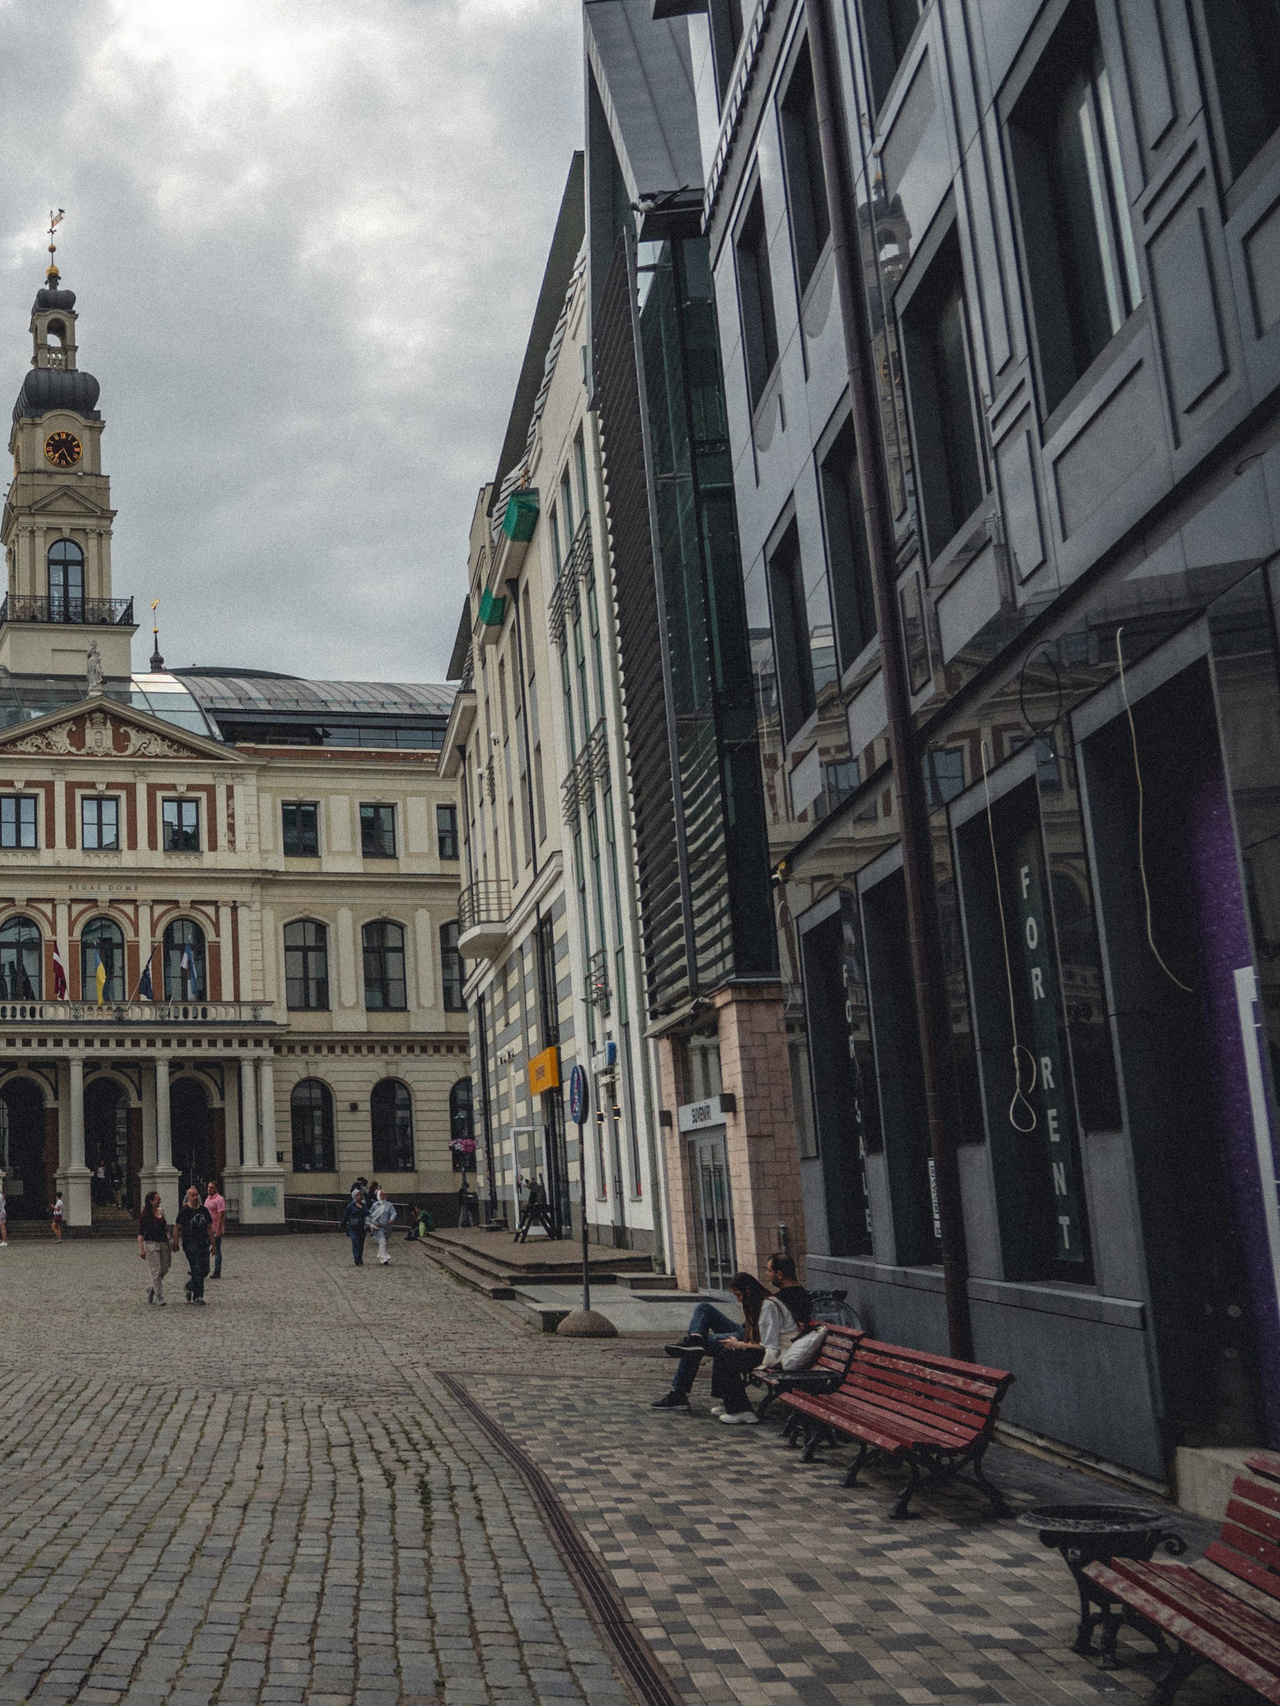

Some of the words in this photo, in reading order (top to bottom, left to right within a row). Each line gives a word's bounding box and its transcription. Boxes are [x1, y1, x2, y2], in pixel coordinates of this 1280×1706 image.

[842, 964, 856, 1058] FOR
[1020, 865, 1045, 1000] FOR
[1040, 1056, 1070, 1249] RENT
